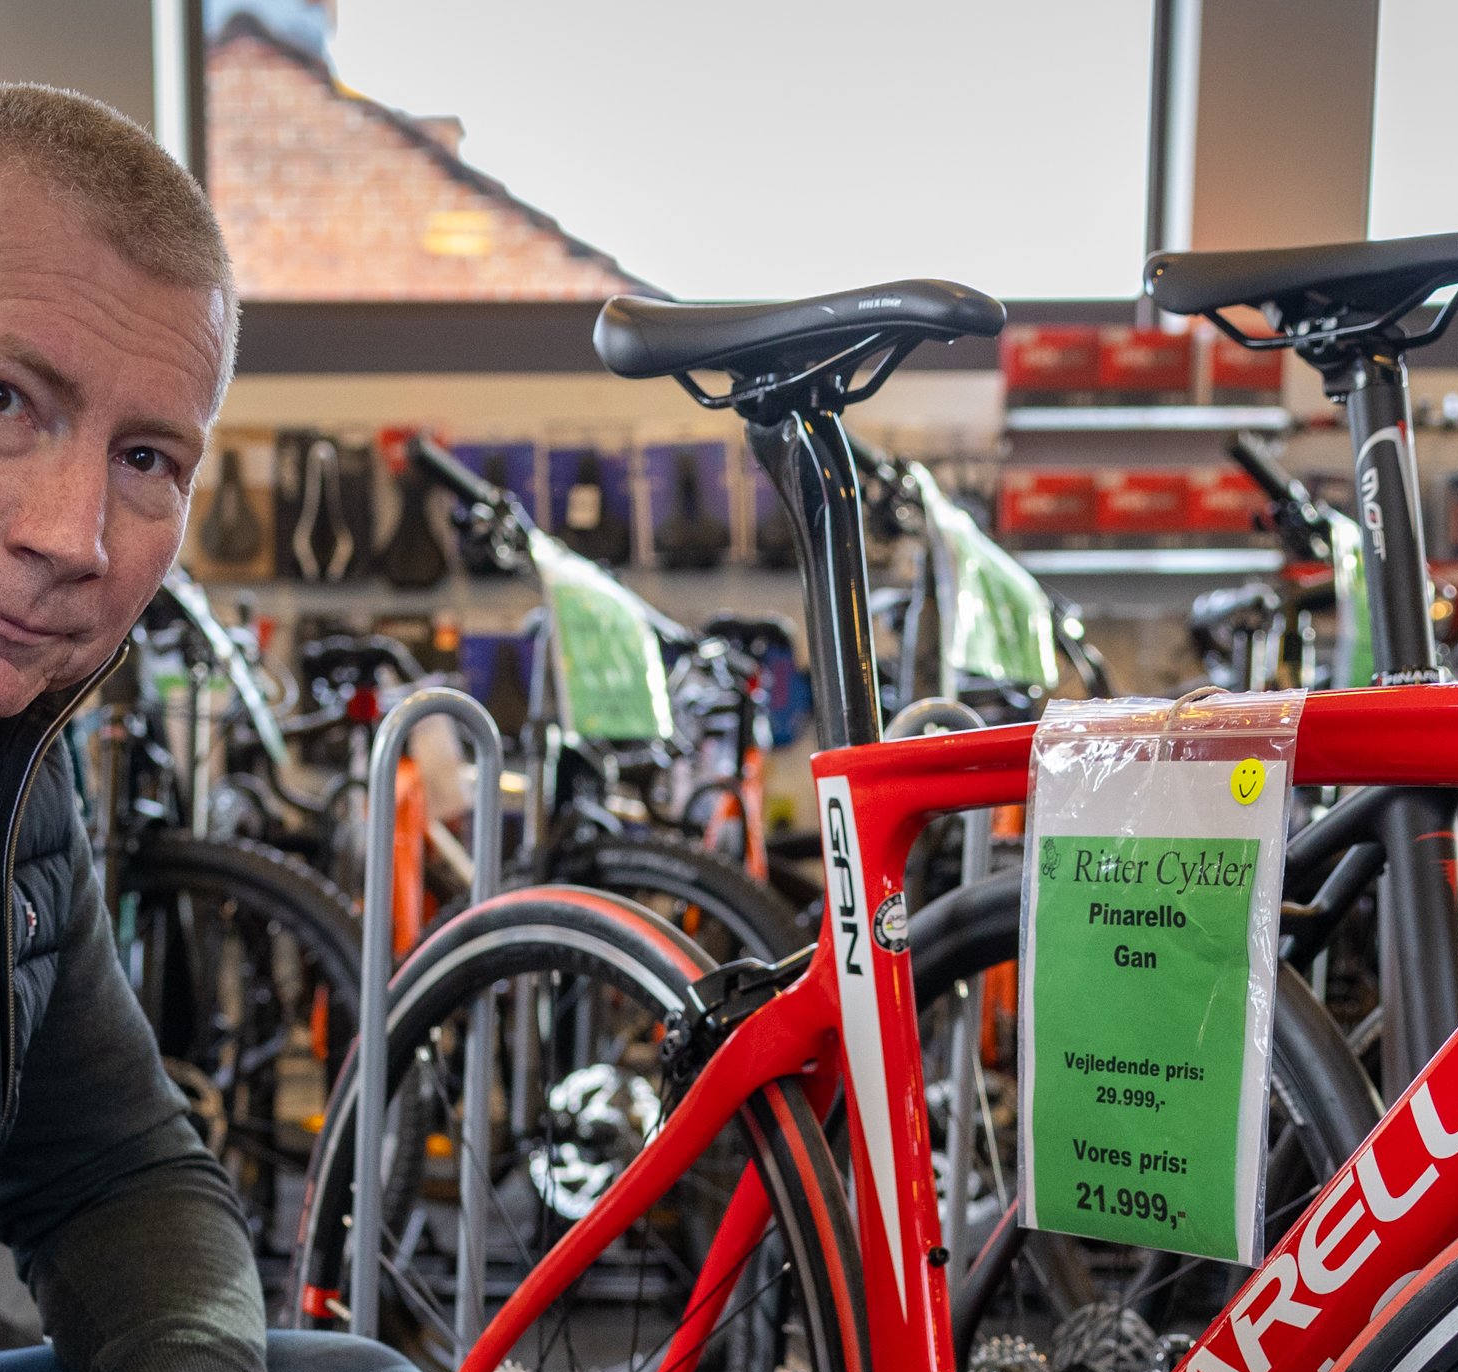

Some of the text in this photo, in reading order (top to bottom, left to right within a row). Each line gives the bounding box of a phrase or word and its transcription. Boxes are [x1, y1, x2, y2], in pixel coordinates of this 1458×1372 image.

[828, 797, 864, 977] GAN
[1073, 848, 1252, 895] Ritter Cykler
[1088, 903, 1187, 929] Pinarello
[1113, 945, 1158, 969] Gan
[1063, 1052, 1205, 1086] Vejledende pris:
[1095, 1086, 1167, 1113] 29.999,-
[1073, 1138, 1188, 1179] Vores pris:
[1075, 1182, 1187, 1230] 21.999,-
